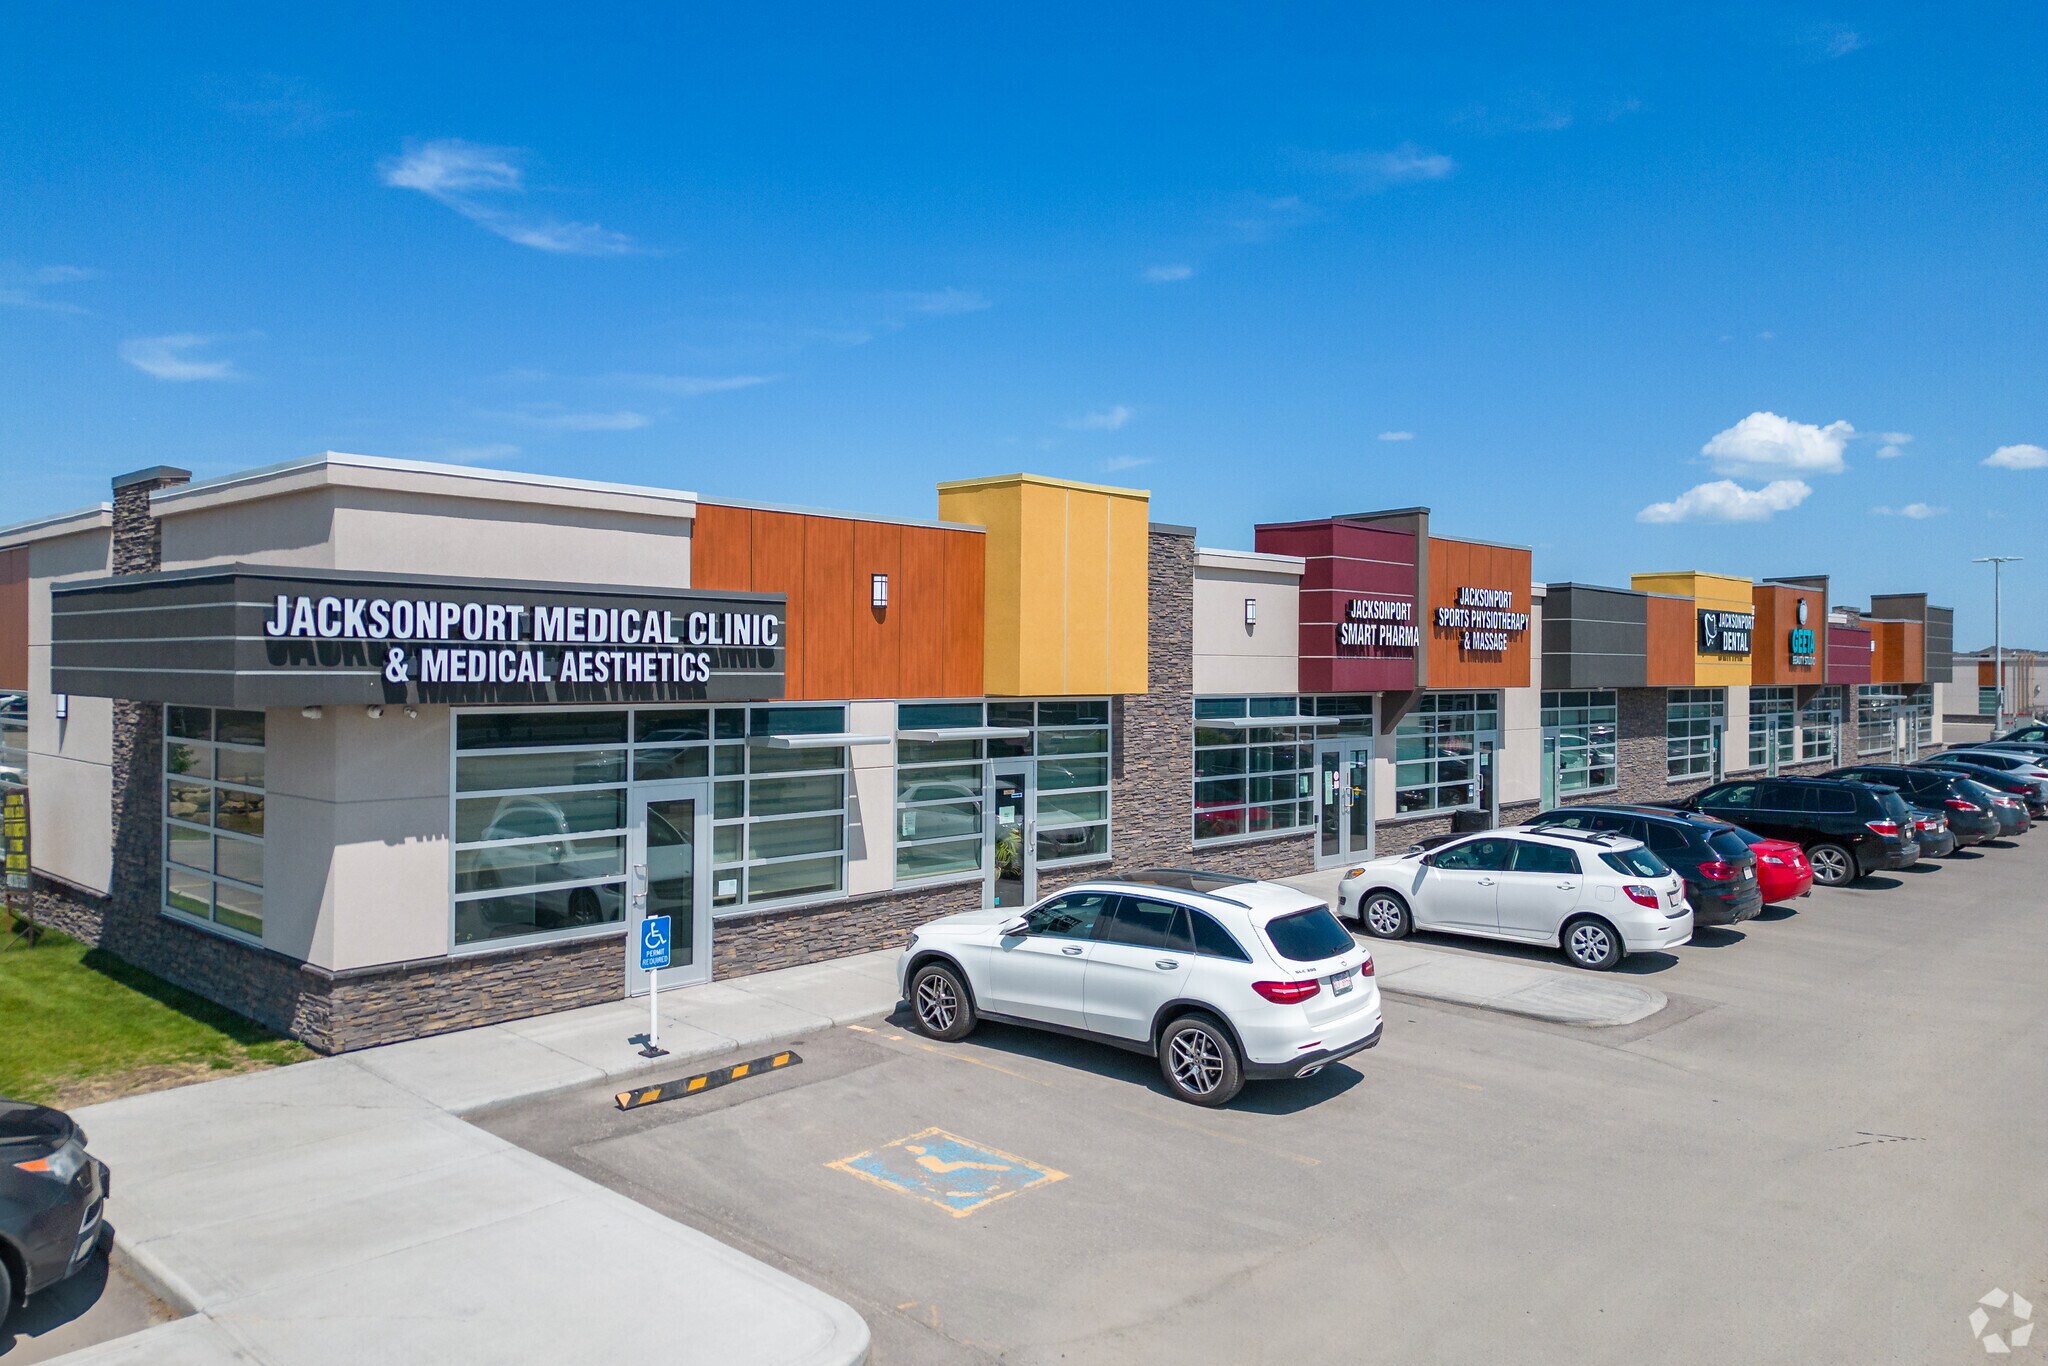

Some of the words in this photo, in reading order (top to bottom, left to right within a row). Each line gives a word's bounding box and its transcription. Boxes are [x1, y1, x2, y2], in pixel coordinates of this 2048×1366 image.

[1459, 587, 1512, 608] JACKSONPORT
[1351, 599, 1411, 621] JACKSONPORT
[1438, 607, 1469, 628] SPORTS
[1471, 610, 1529, 630] PHYSIOTHERAPY
[266, 595, 524, 642] JACKSONPORT
[533, 606, 679, 644] MEDICAL
[688, 611, 778, 647] CLINIC
[1718, 613, 1754, 629] JACKSONPORT
[1341, 623, 1377, 646] SMART
[1379, 625, 1420, 647] PHARMA
[1464, 631, 1471, 650] &
[1472, 632, 1508, 651] MASSAGE
[1723, 631, 1749, 651] DENTAL
[1792, 628, 1815, 654] GEETA
[384, 647, 409, 683] &
[420, 648, 551, 683] MEDICAL
[559, 651, 710, 683] AESTHETICS
[642, 955, 668, 965] REQUIRED
[646, 948, 665, 957] PERMIT
